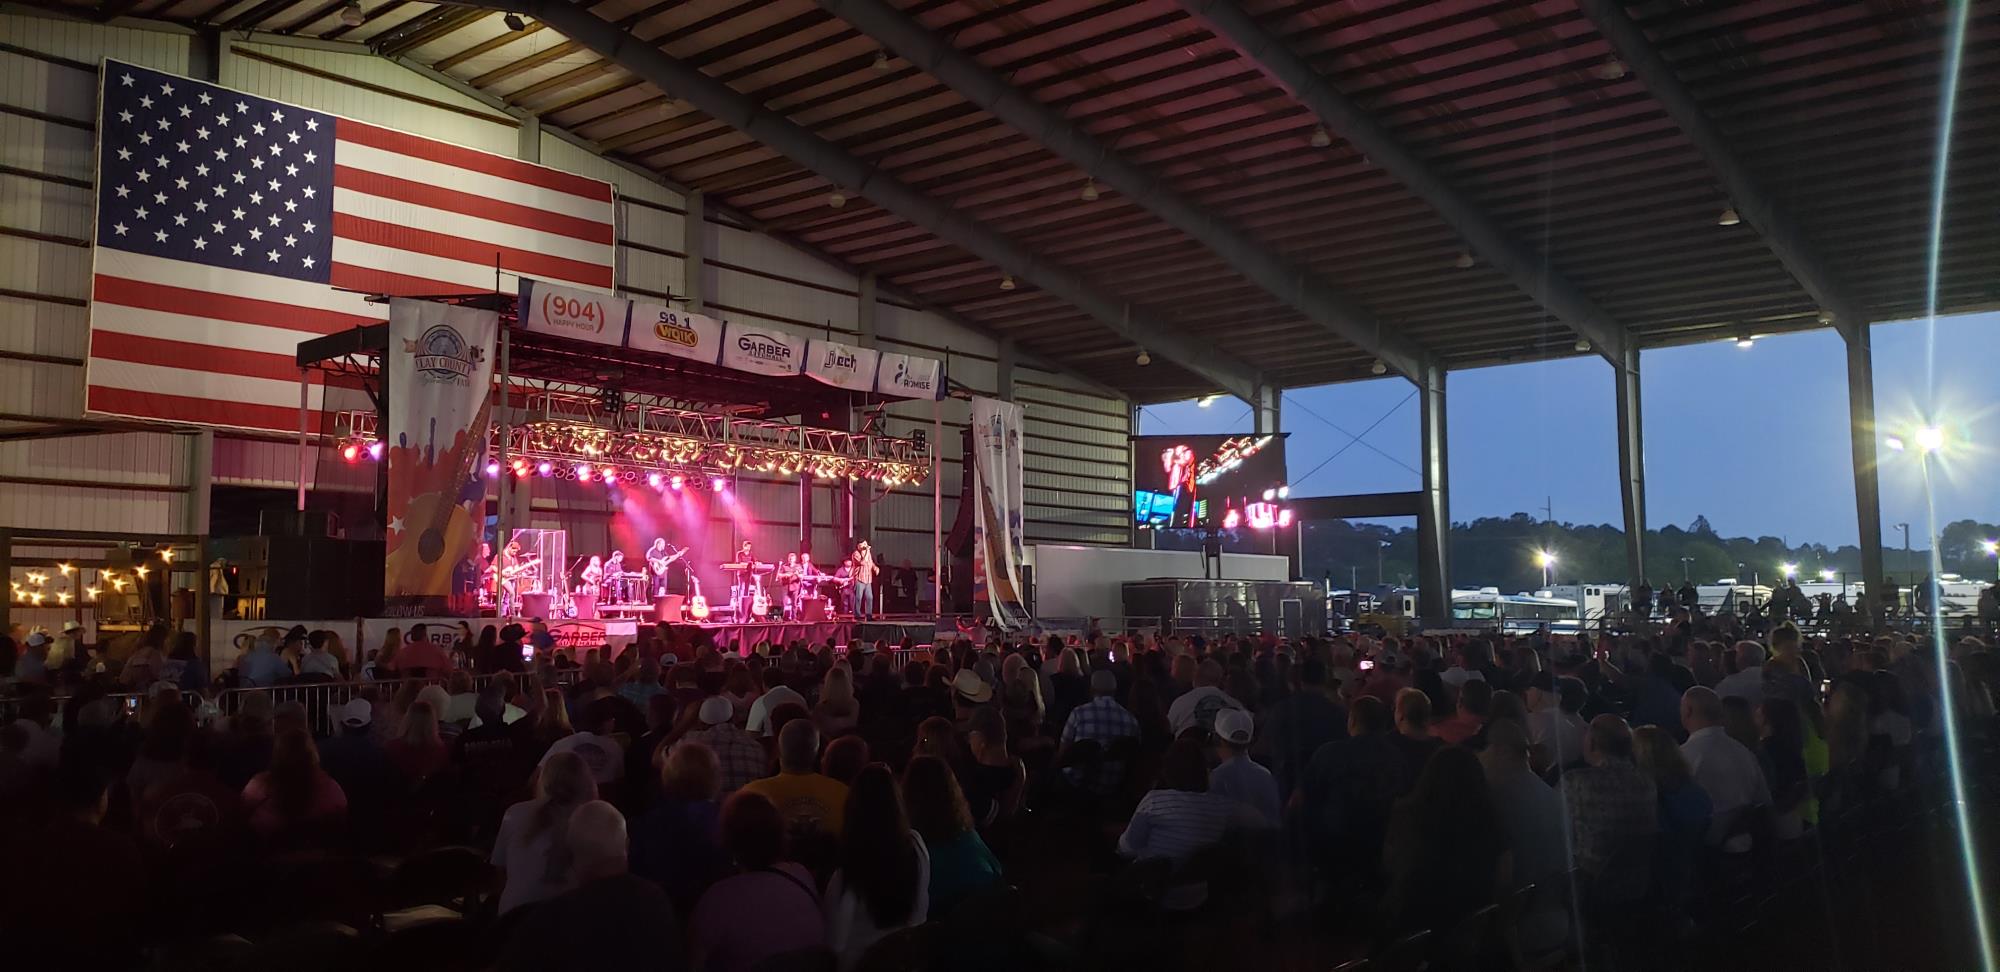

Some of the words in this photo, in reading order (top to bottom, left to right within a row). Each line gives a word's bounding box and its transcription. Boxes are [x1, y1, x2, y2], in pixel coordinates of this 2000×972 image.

[543, 293, 604, 334] (904)
[553, 319, 574, 328] HAPPY
[575, 323, 594, 331] HOUR
[738, 337, 791, 358] GARBER
[415, 357, 436, 369] CLAY
[903, 379, 931, 390] ROMISE
[549, 629, 607, 643] GARBER
